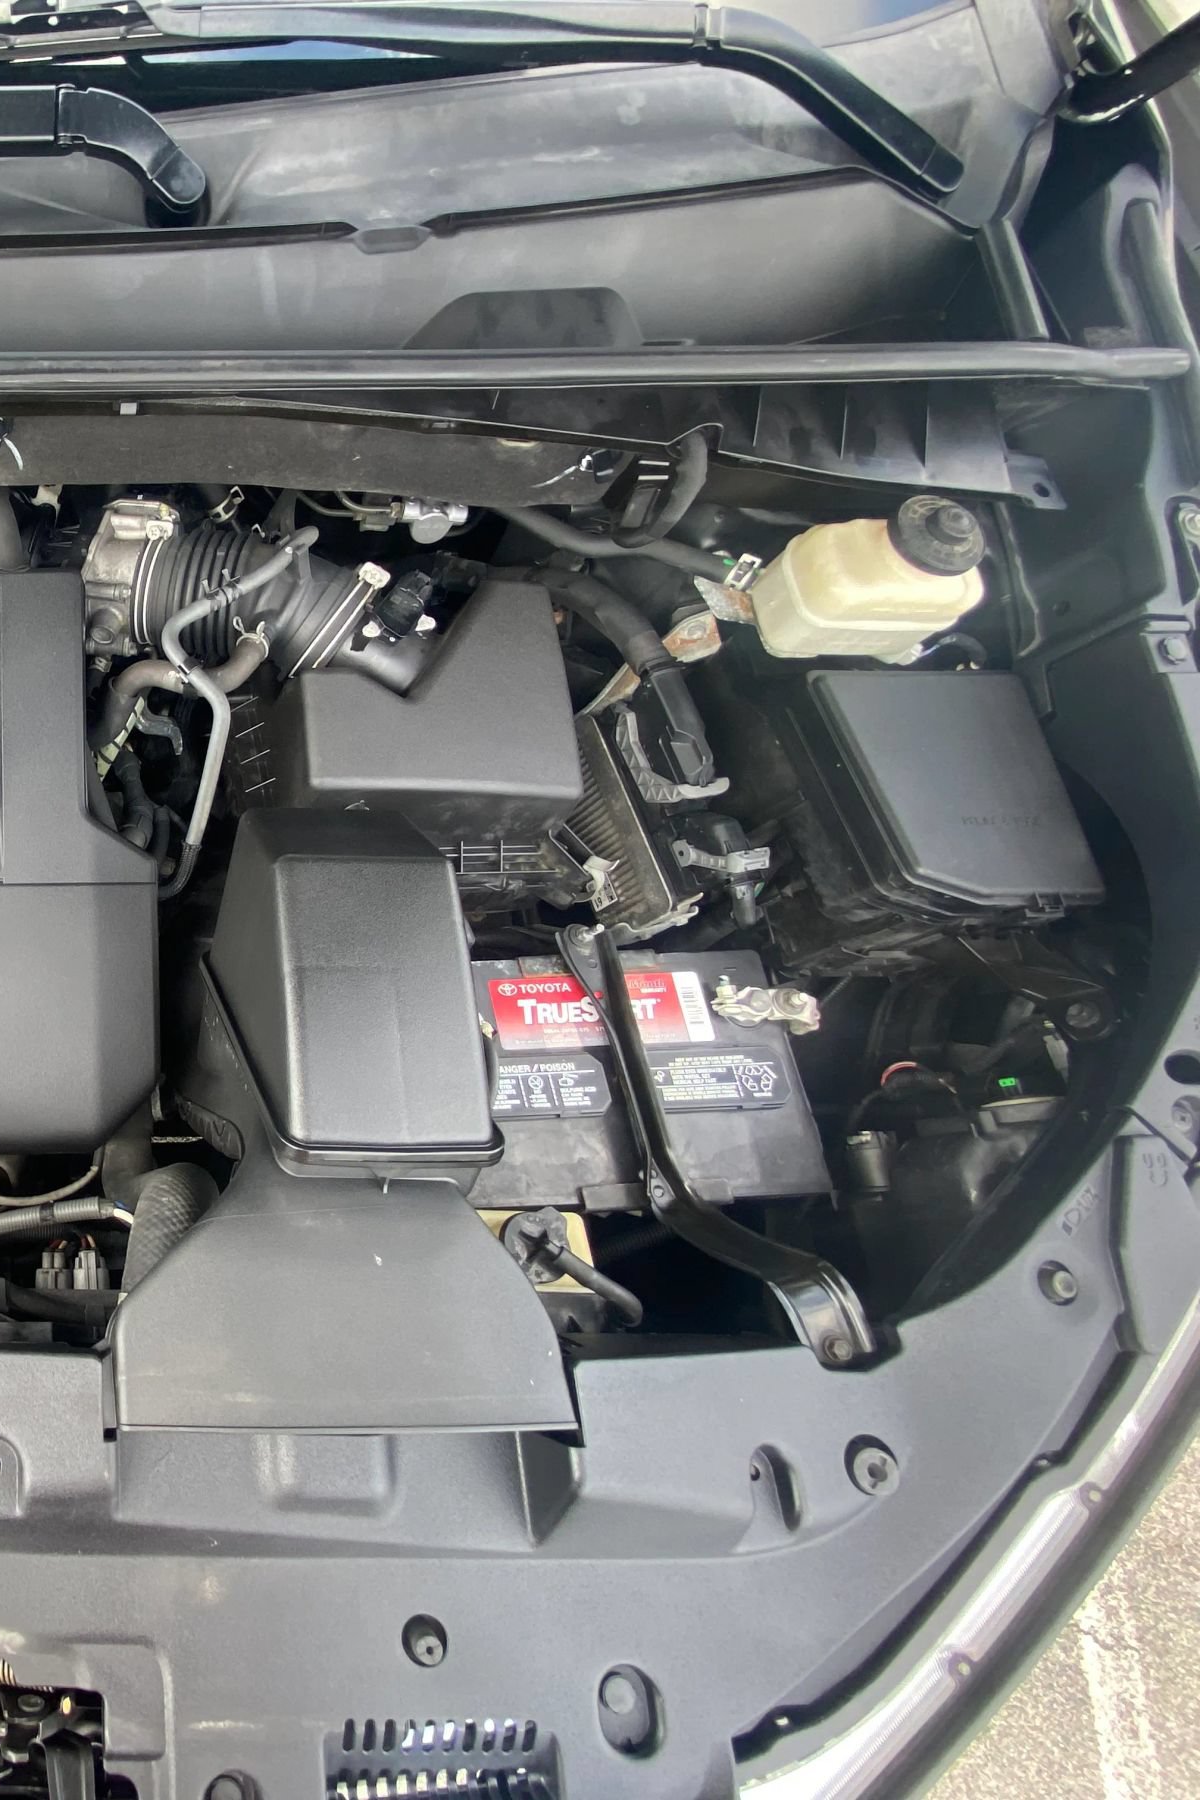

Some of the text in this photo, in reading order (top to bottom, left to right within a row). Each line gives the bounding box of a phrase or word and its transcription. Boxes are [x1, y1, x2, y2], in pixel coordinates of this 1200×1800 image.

[519, 983, 572, 994] TOYOTA
[499, 1065, 531, 1073] ANGER
[540, 1062, 576, 1072] POISON
